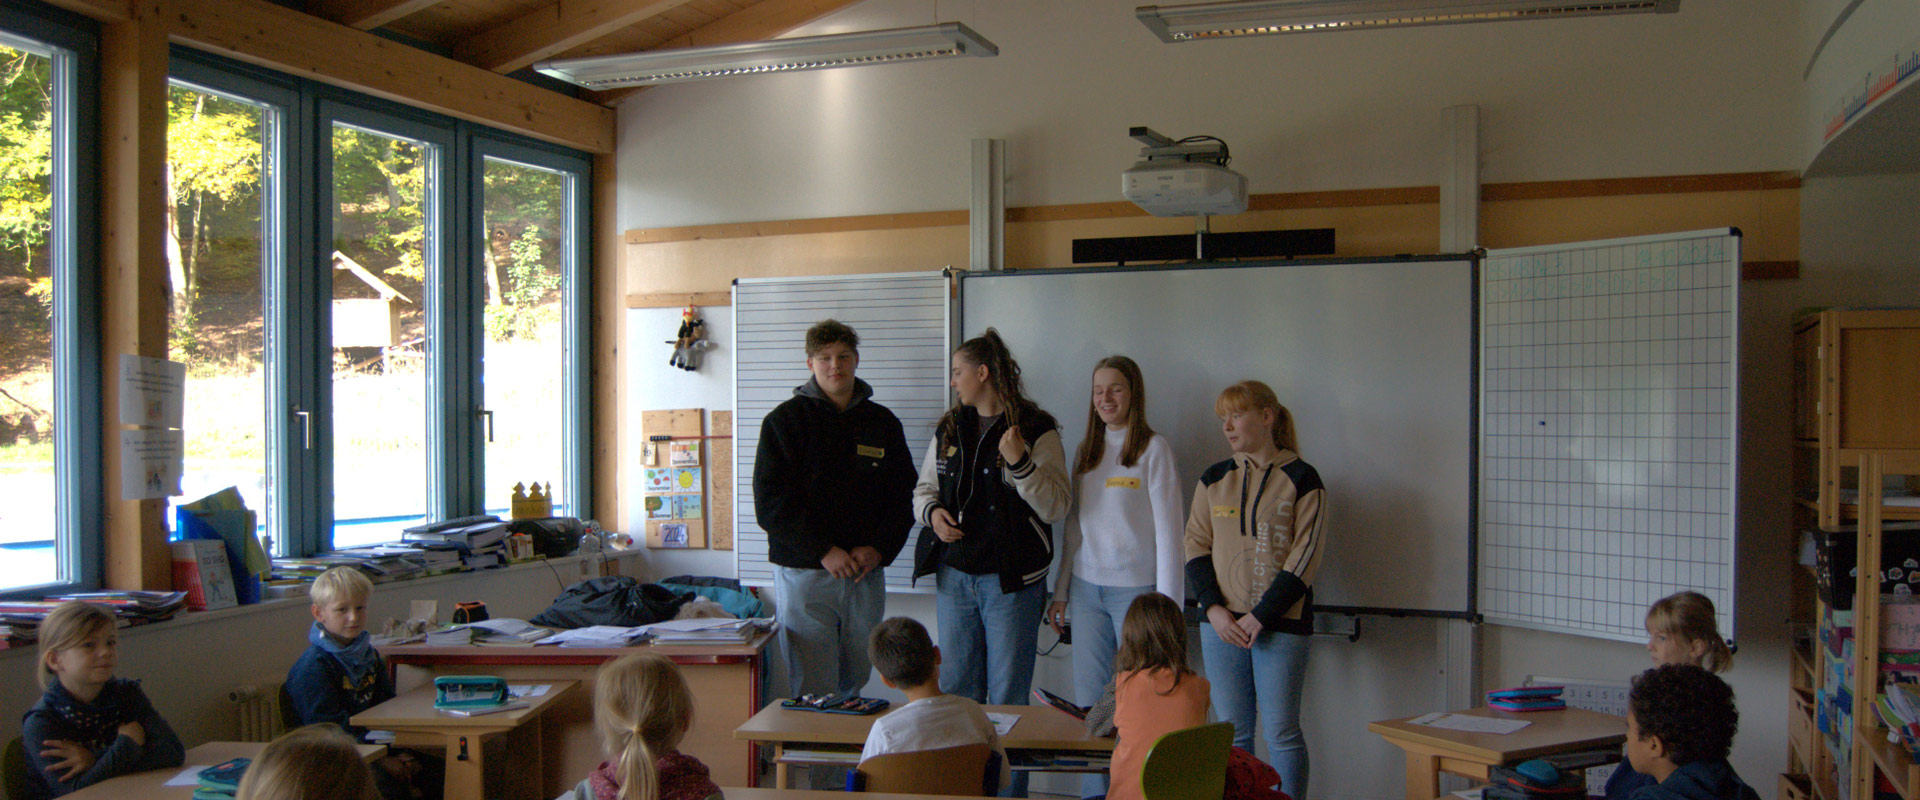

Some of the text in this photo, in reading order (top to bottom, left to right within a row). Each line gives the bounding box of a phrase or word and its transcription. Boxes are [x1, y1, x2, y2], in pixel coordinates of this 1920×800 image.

[664, 526, 685, 543] 2024
[1255, 521, 1269, 553] THIS
[1253, 557, 1266, 577] OF
[1569, 688, 1625, 701] 3 4 5 6
[1615, 708, 1627, 717] 16
[1597, 768, 1609, 778] 55
